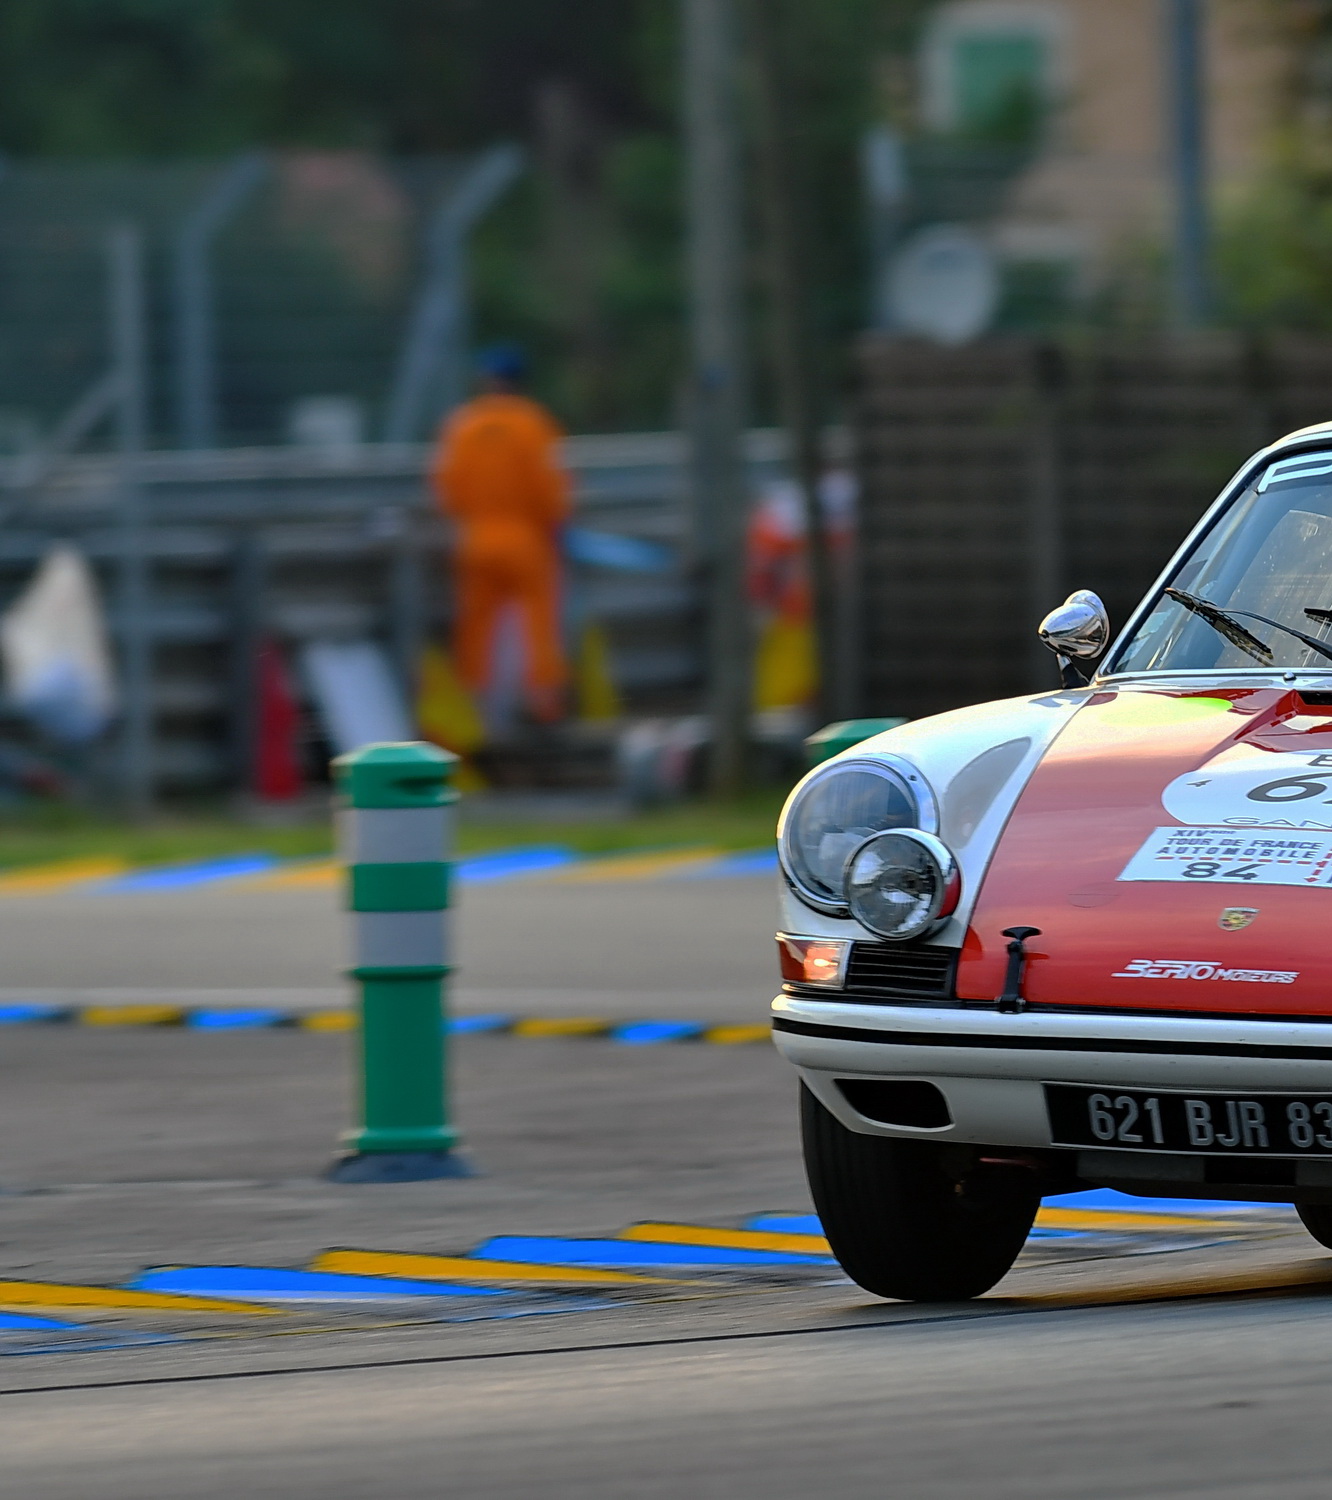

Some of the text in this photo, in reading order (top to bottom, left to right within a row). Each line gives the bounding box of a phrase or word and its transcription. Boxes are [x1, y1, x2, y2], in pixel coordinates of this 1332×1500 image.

[1218, 838, 1246, 847] DE
[1250, 839, 1325, 850] FRANCE
[1155, 846, 1318, 859] AUTOMOBILE
[1182, 861, 1267, 881] 84
[1087, 1093, 1165, 1144] 621
[1184, 1099, 1270, 1148] BJR
